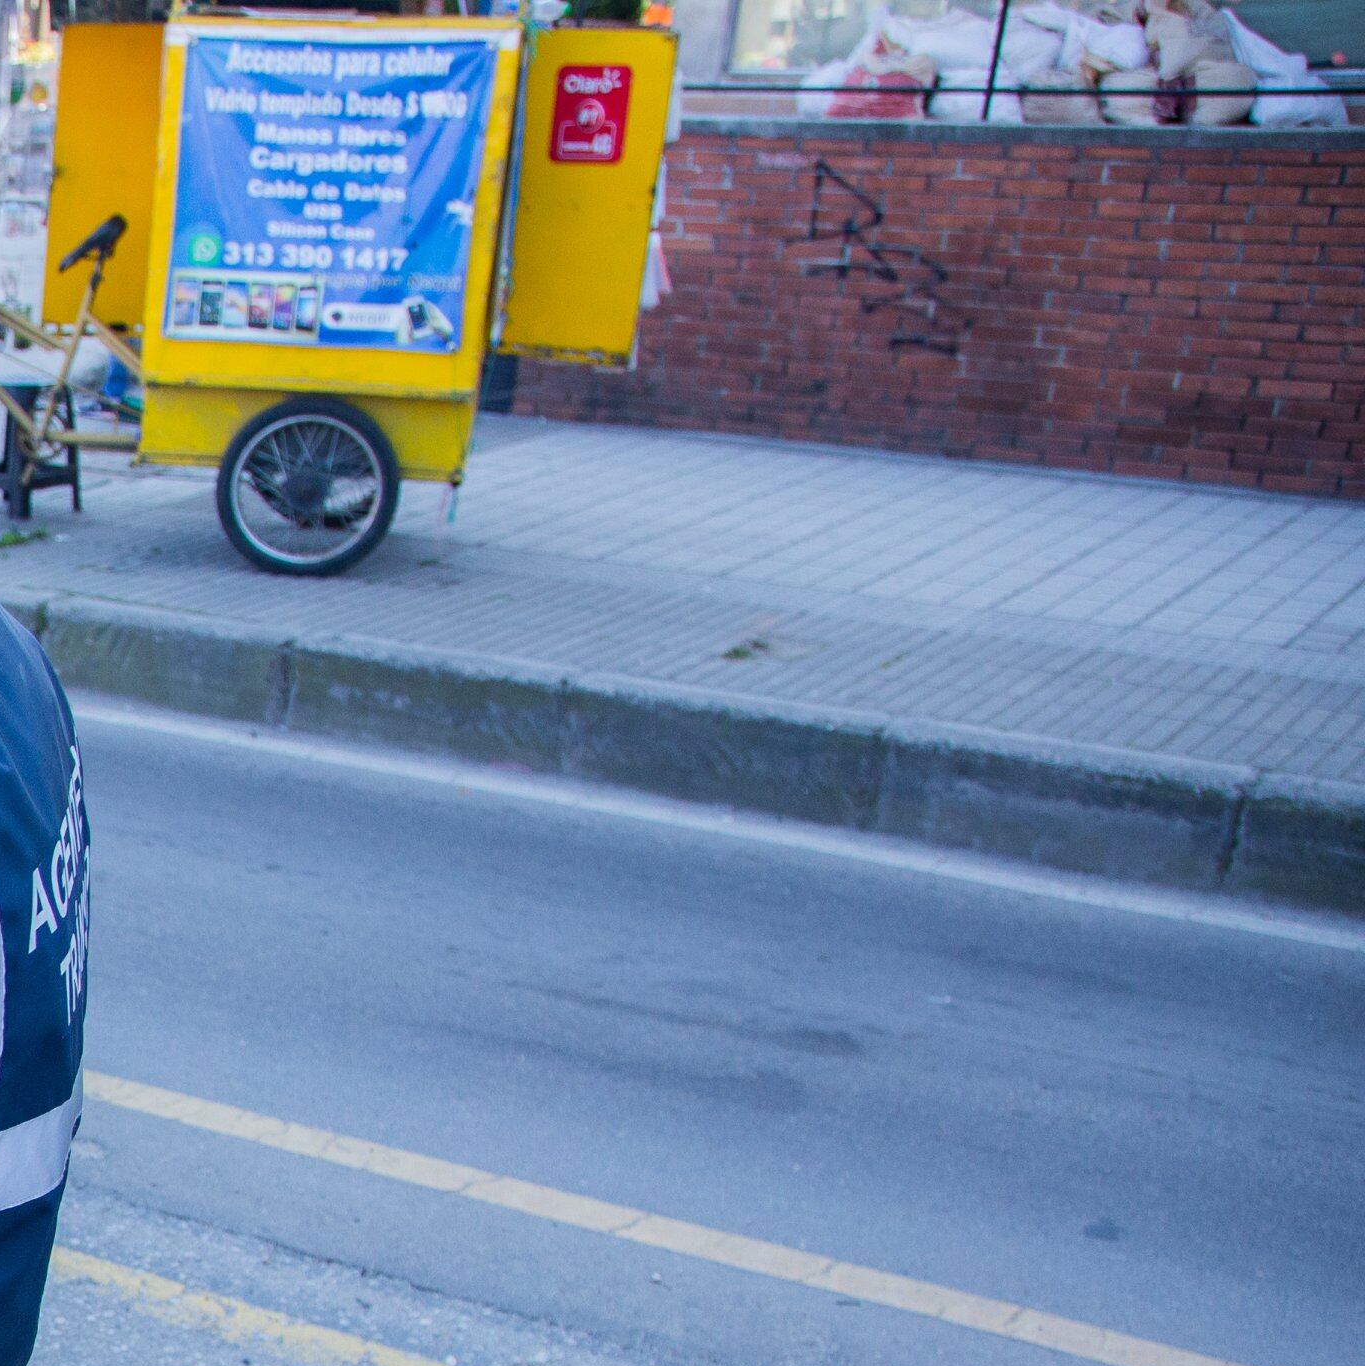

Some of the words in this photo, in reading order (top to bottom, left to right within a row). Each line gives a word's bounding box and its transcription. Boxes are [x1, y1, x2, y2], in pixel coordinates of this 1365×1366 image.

[226, 42, 332, 76] Accesorios
[334, 50, 380, 82] para
[383, 46, 455, 77] celular
[205, 86, 257, 114] Vidrio
[260, 90, 343, 119] templado
[345, 91, 402, 117] Desde
[255, 122, 333, 146] Manos
[338, 123, 406, 147] libres
[249, 146, 408, 176] Cargadores
[247, 178, 308, 200] Cable
[311, 181, 340, 201] de
[344, 182, 407, 203] Datos
[222, 241, 274, 266] 313
[279, 244, 333, 269] 390
[340, 246, 409, 271] 1417
